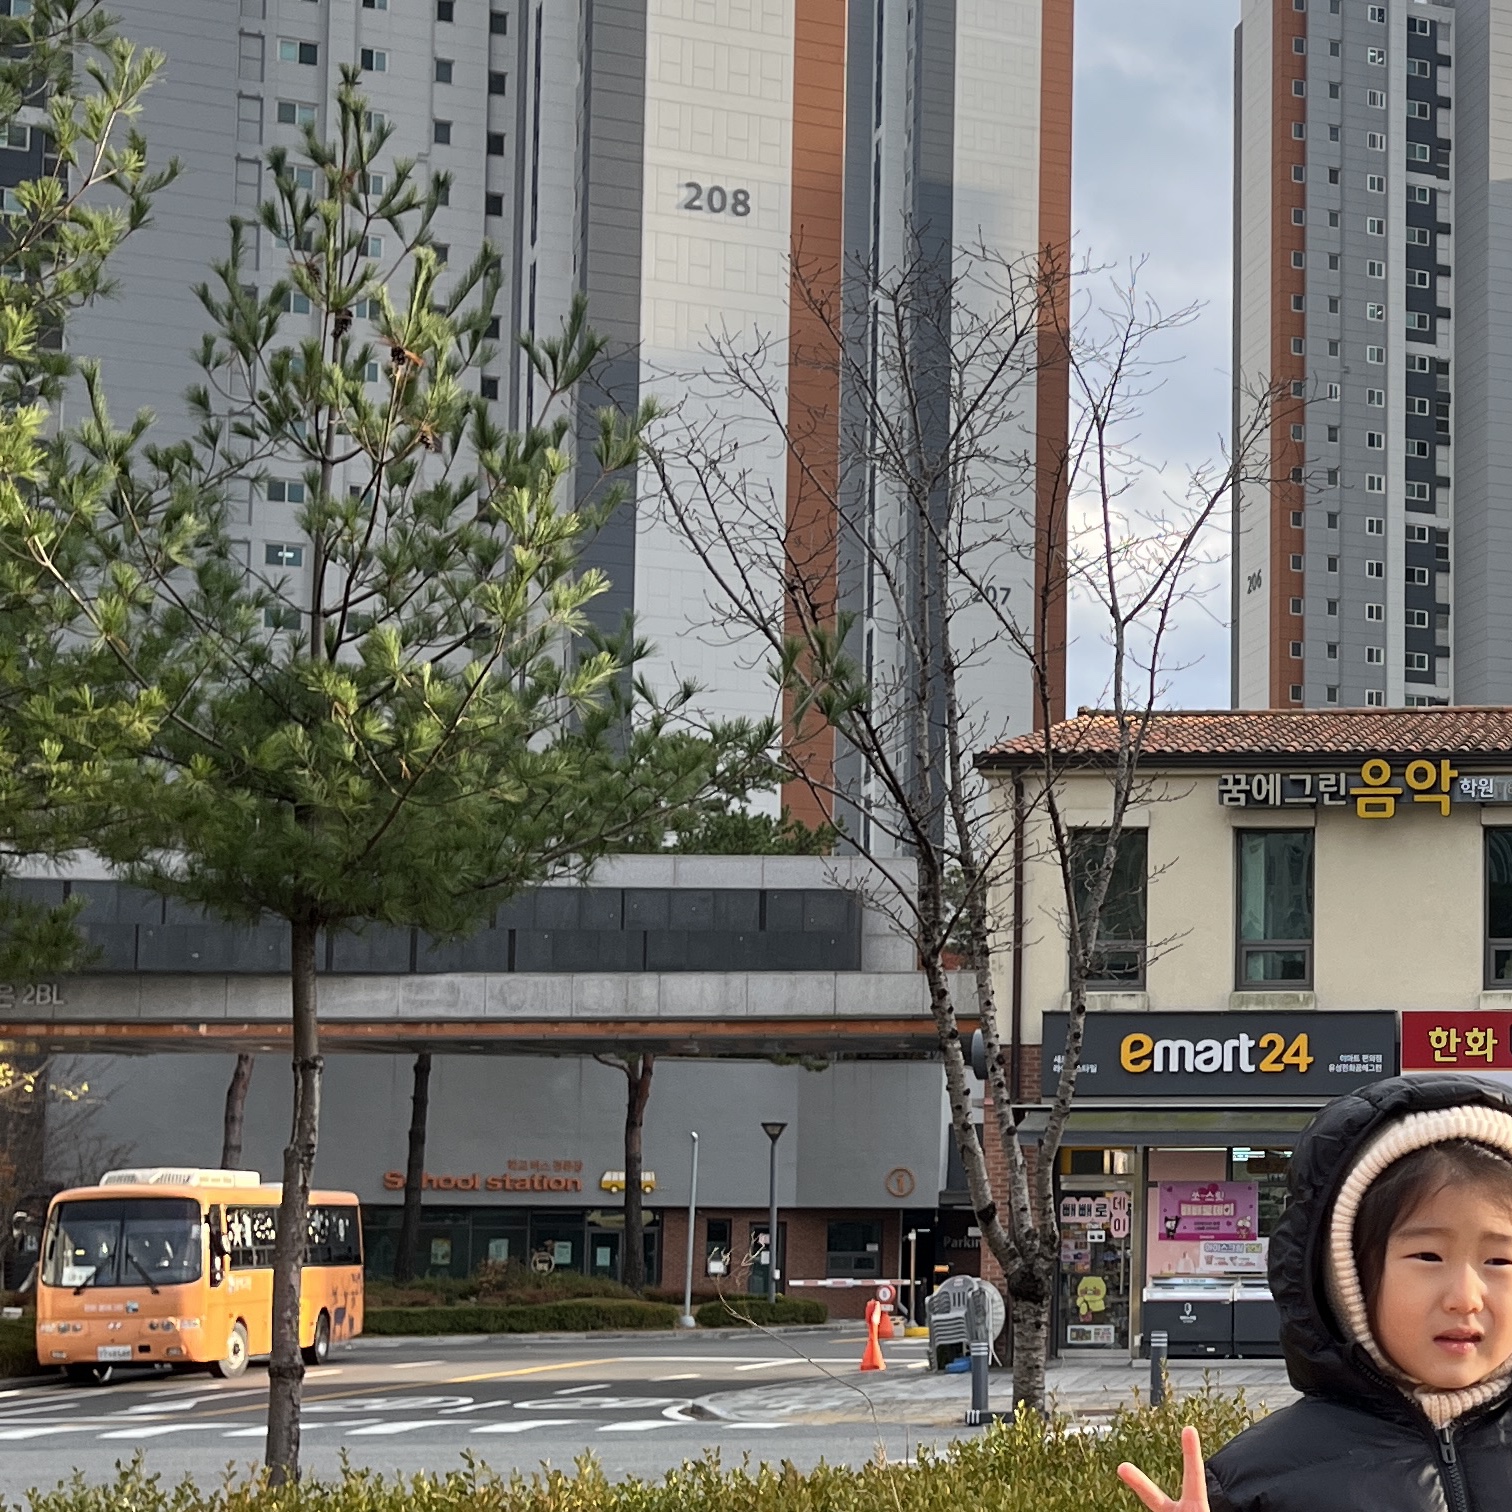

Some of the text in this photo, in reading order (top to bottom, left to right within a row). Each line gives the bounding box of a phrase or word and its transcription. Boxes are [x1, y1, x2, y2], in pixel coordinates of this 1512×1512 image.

[682, 181, 752, 217] 208
[1218, 772, 1348, 807] 꿈에그린
[1349, 757, 1459, 820] 음악
[1459, 777, 1495, 800] 학원
[22, 983, 65, 1006] 2BL
[1119, 1031, 1315, 1074] emart24
[1427, 1026, 1499, 1063] 한화
[385, 1170, 583, 1192] Shool station
[1062, 1203, 1108, 1218] 빼빼로
